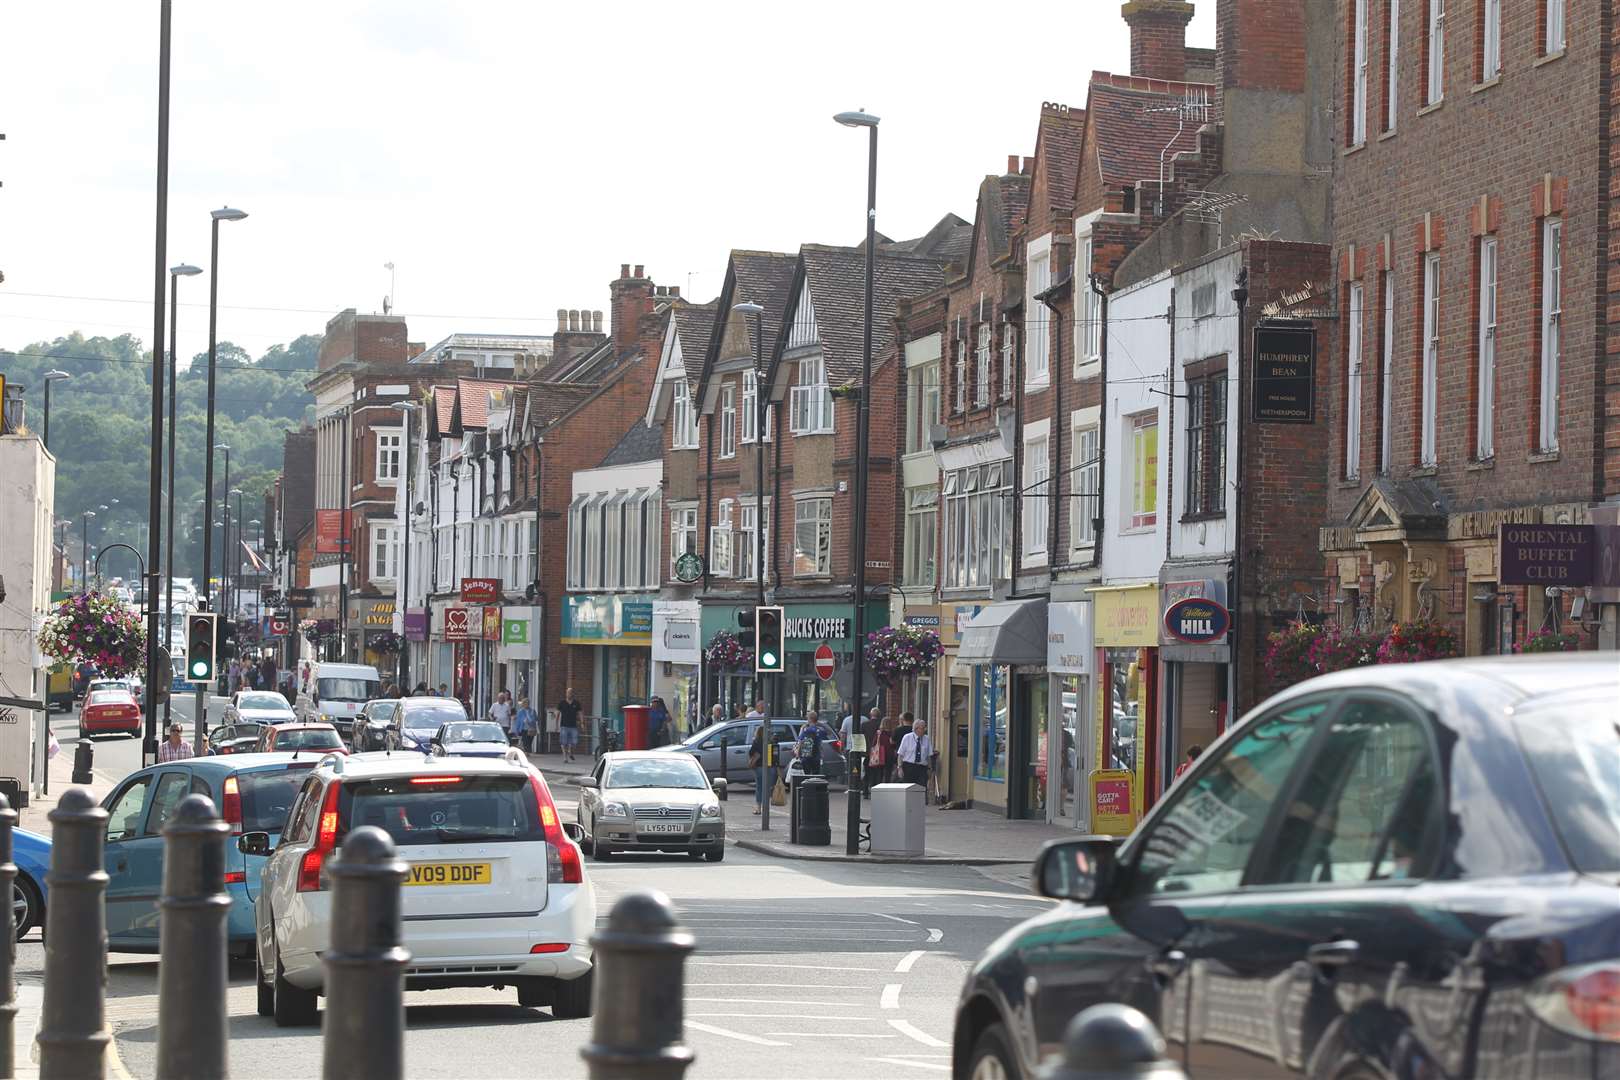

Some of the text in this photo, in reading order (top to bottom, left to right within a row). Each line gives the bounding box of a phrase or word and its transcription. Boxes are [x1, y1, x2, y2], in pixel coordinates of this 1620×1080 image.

[1259, 352, 1310, 363] HUMPHREY
[1272, 367, 1297, 376] BEAN
[1507, 530, 1588, 544] ORIENTAL
[1517, 548, 1577, 562] BUFFET
[1525, 565, 1569, 578] CLUB
[463, 581, 494, 593] Jenny's
[911, 617, 938, 625] GREGGS
[1180, 619, 1214, 635] HILL
[814, 617, 845, 639] COFFEE
[406, 865, 484, 882] V09 DDF
